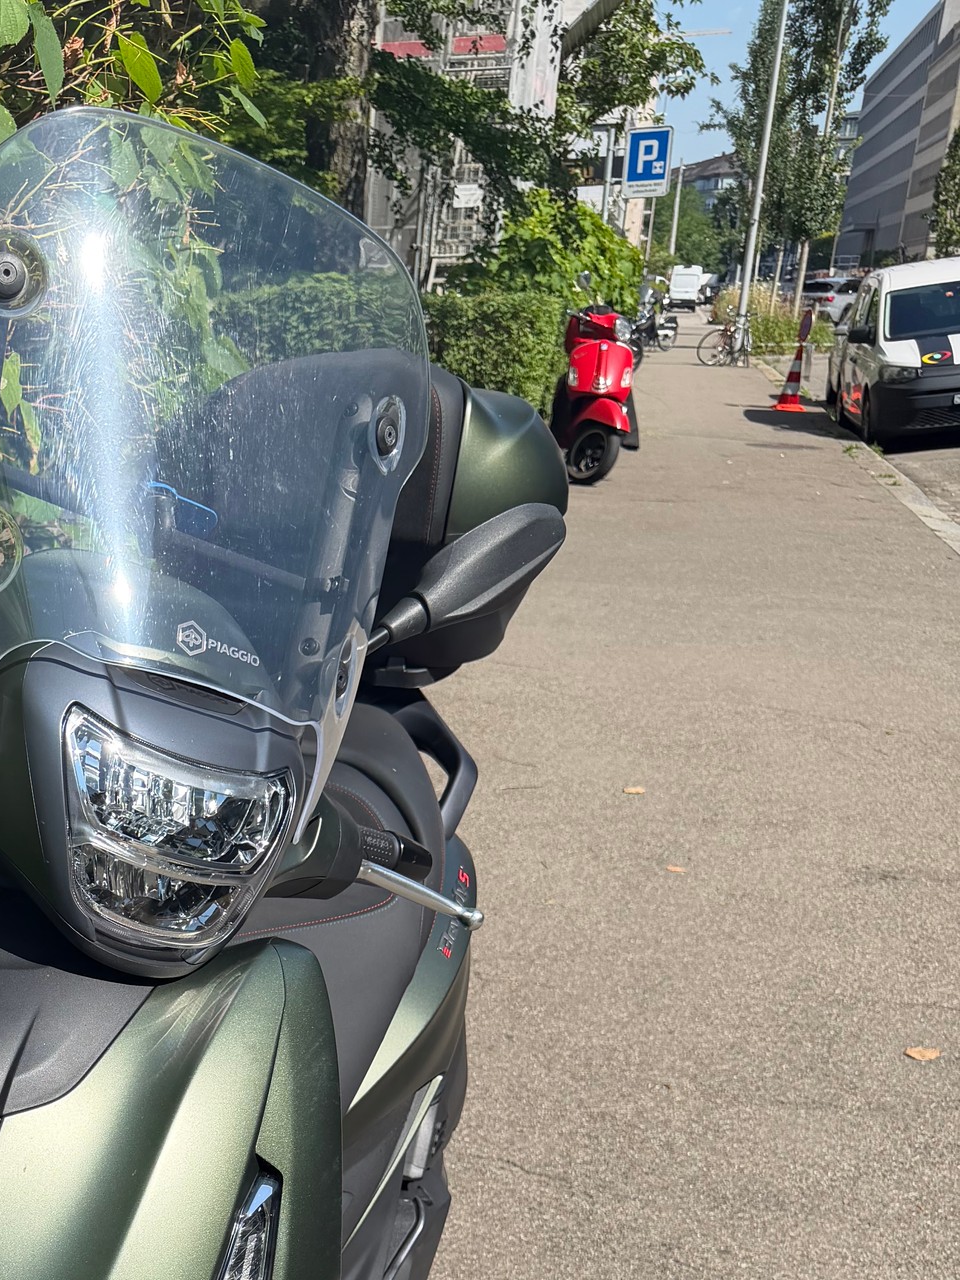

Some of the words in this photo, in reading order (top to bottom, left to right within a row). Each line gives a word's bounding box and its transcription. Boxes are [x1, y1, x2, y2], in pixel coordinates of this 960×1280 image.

[637, 139, 659, 174] P
[208, 638, 260, 667] PIAGGIO
[458, 868, 471, 888] S
